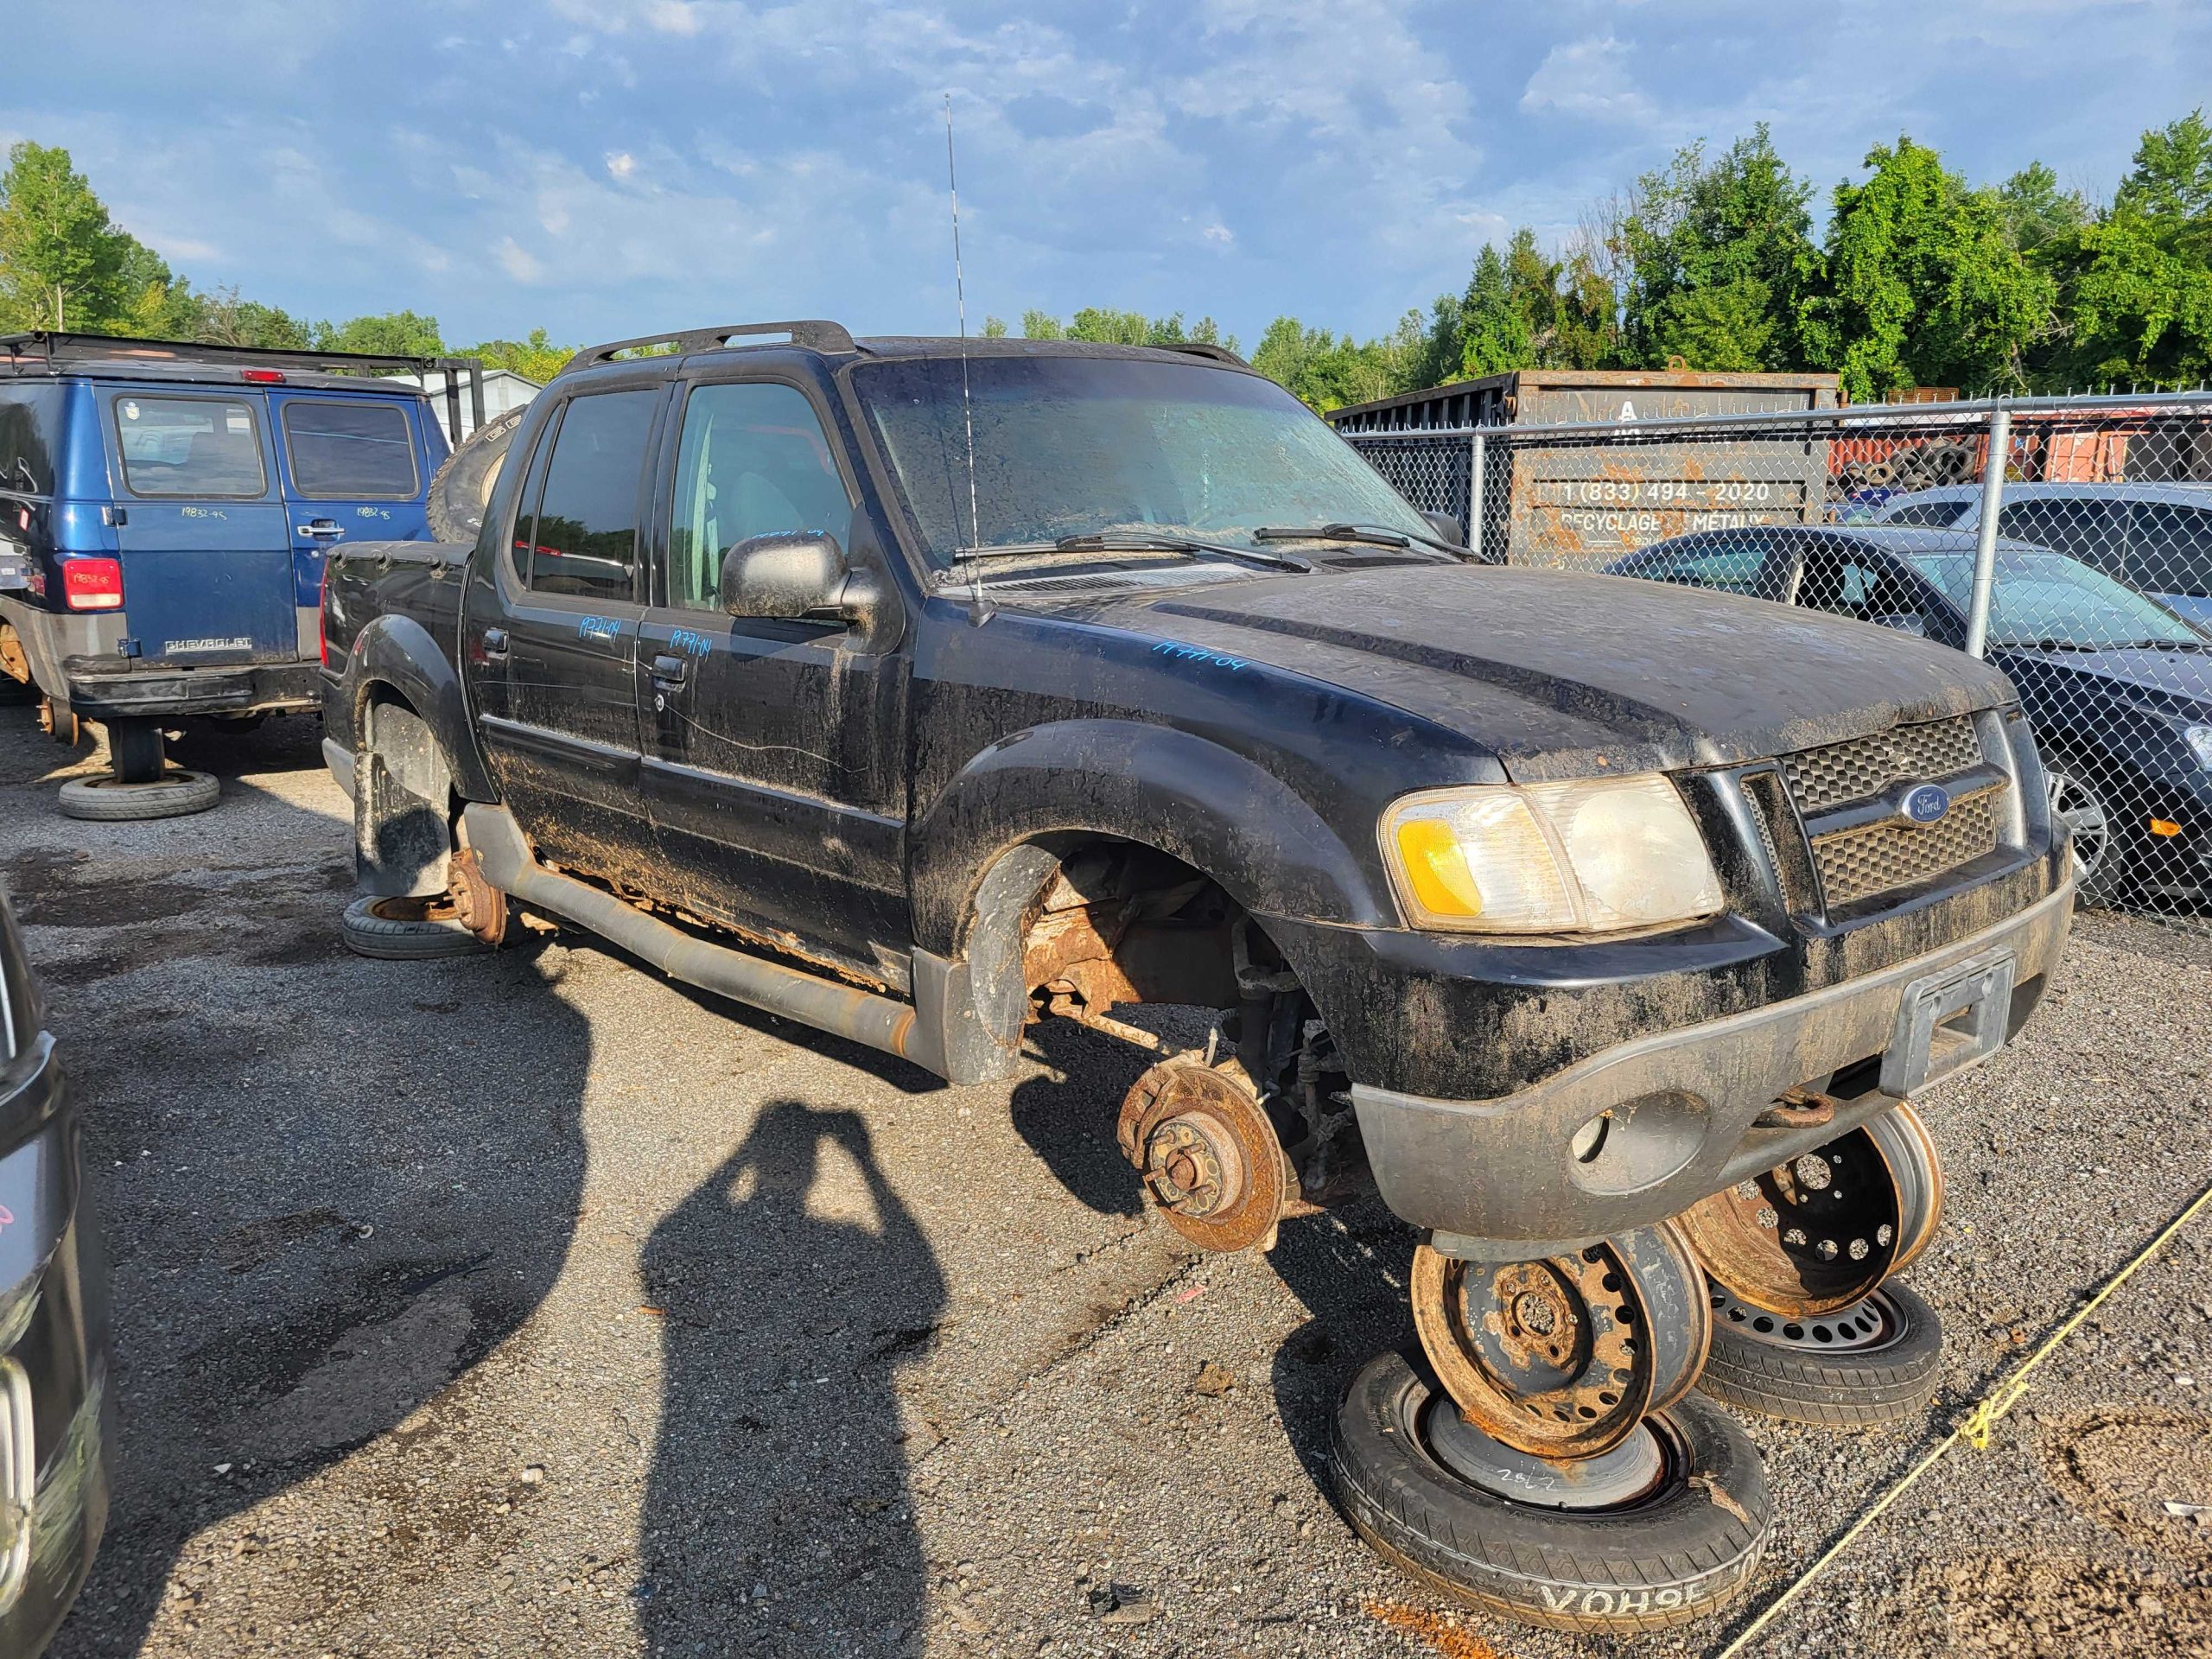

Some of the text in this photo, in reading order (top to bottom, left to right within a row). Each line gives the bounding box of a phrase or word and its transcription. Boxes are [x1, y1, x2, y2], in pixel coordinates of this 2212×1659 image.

[1563, 483, 1573, 501] 1
[1580, 482, 1640, 504] (833)
[1646, 483, 1688, 501] 494
[1714, 483, 1770, 501] 2020
[164, 637, 253, 655] CHEVROLET
[1152, 640, 1251, 671] 19771-04
[1916, 791, 1942, 816] Ford
